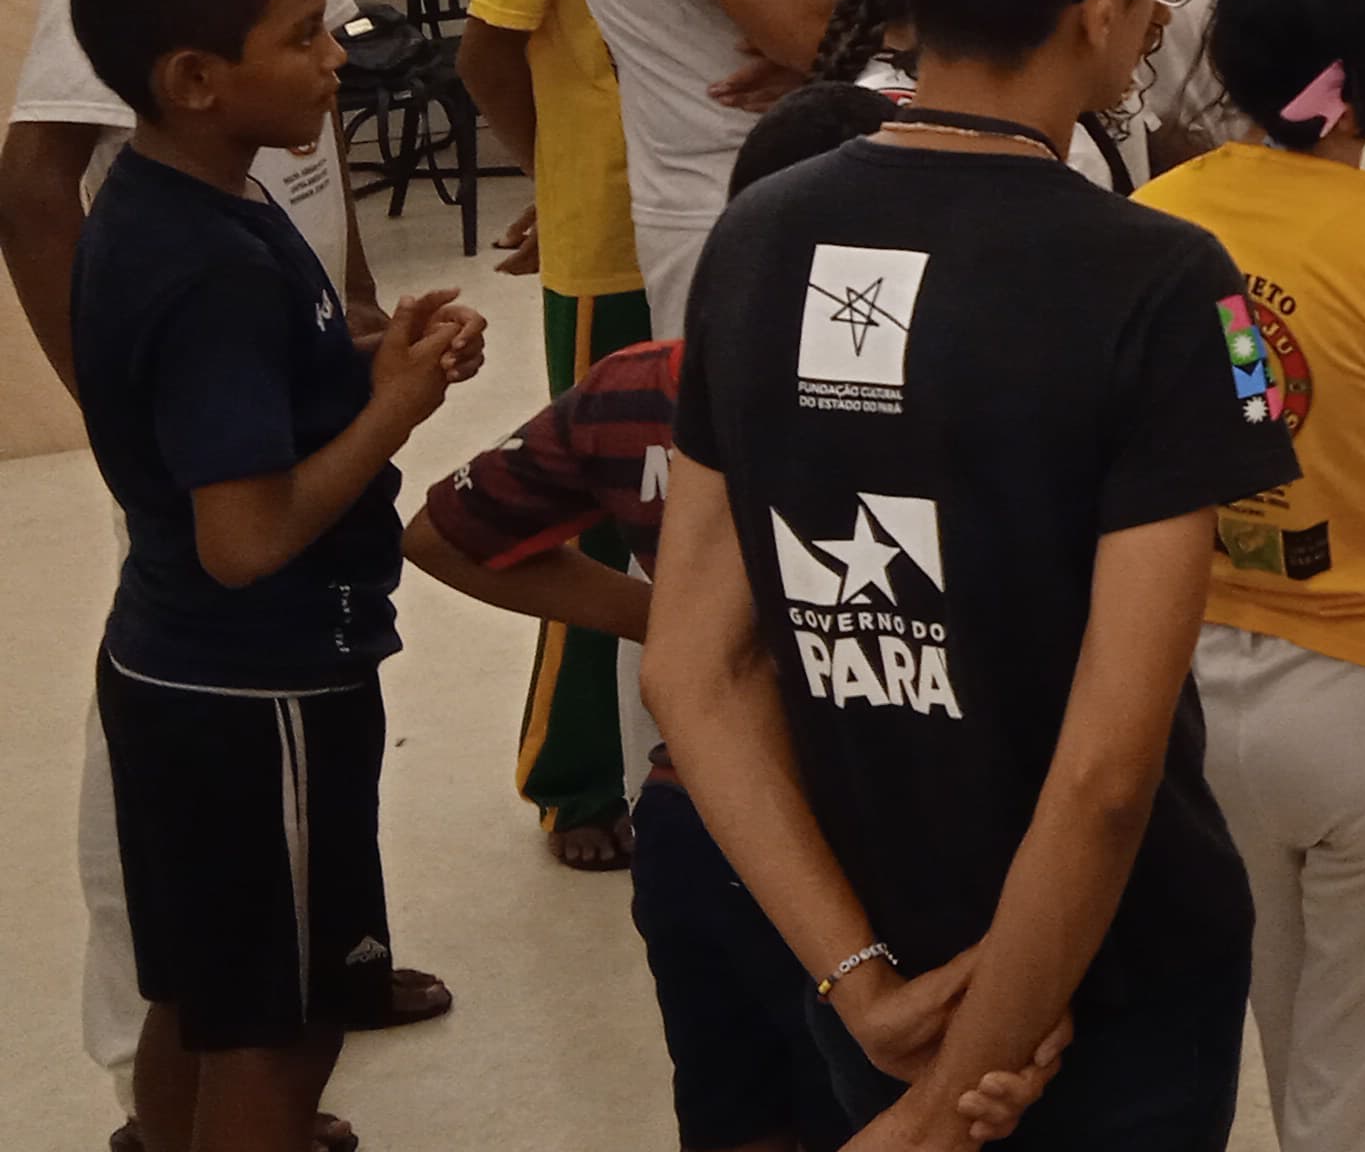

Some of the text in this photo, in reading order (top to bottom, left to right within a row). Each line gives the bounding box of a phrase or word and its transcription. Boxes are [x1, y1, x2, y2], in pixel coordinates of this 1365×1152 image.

[798, 381, 859, 398] FUNDAÇÃO
[800, 395, 816, 408] DO
[818, 397, 861, 411] ESTADO
[862, 400, 877, 412] DO
[789, 606, 946, 642] GOVERNO DO
